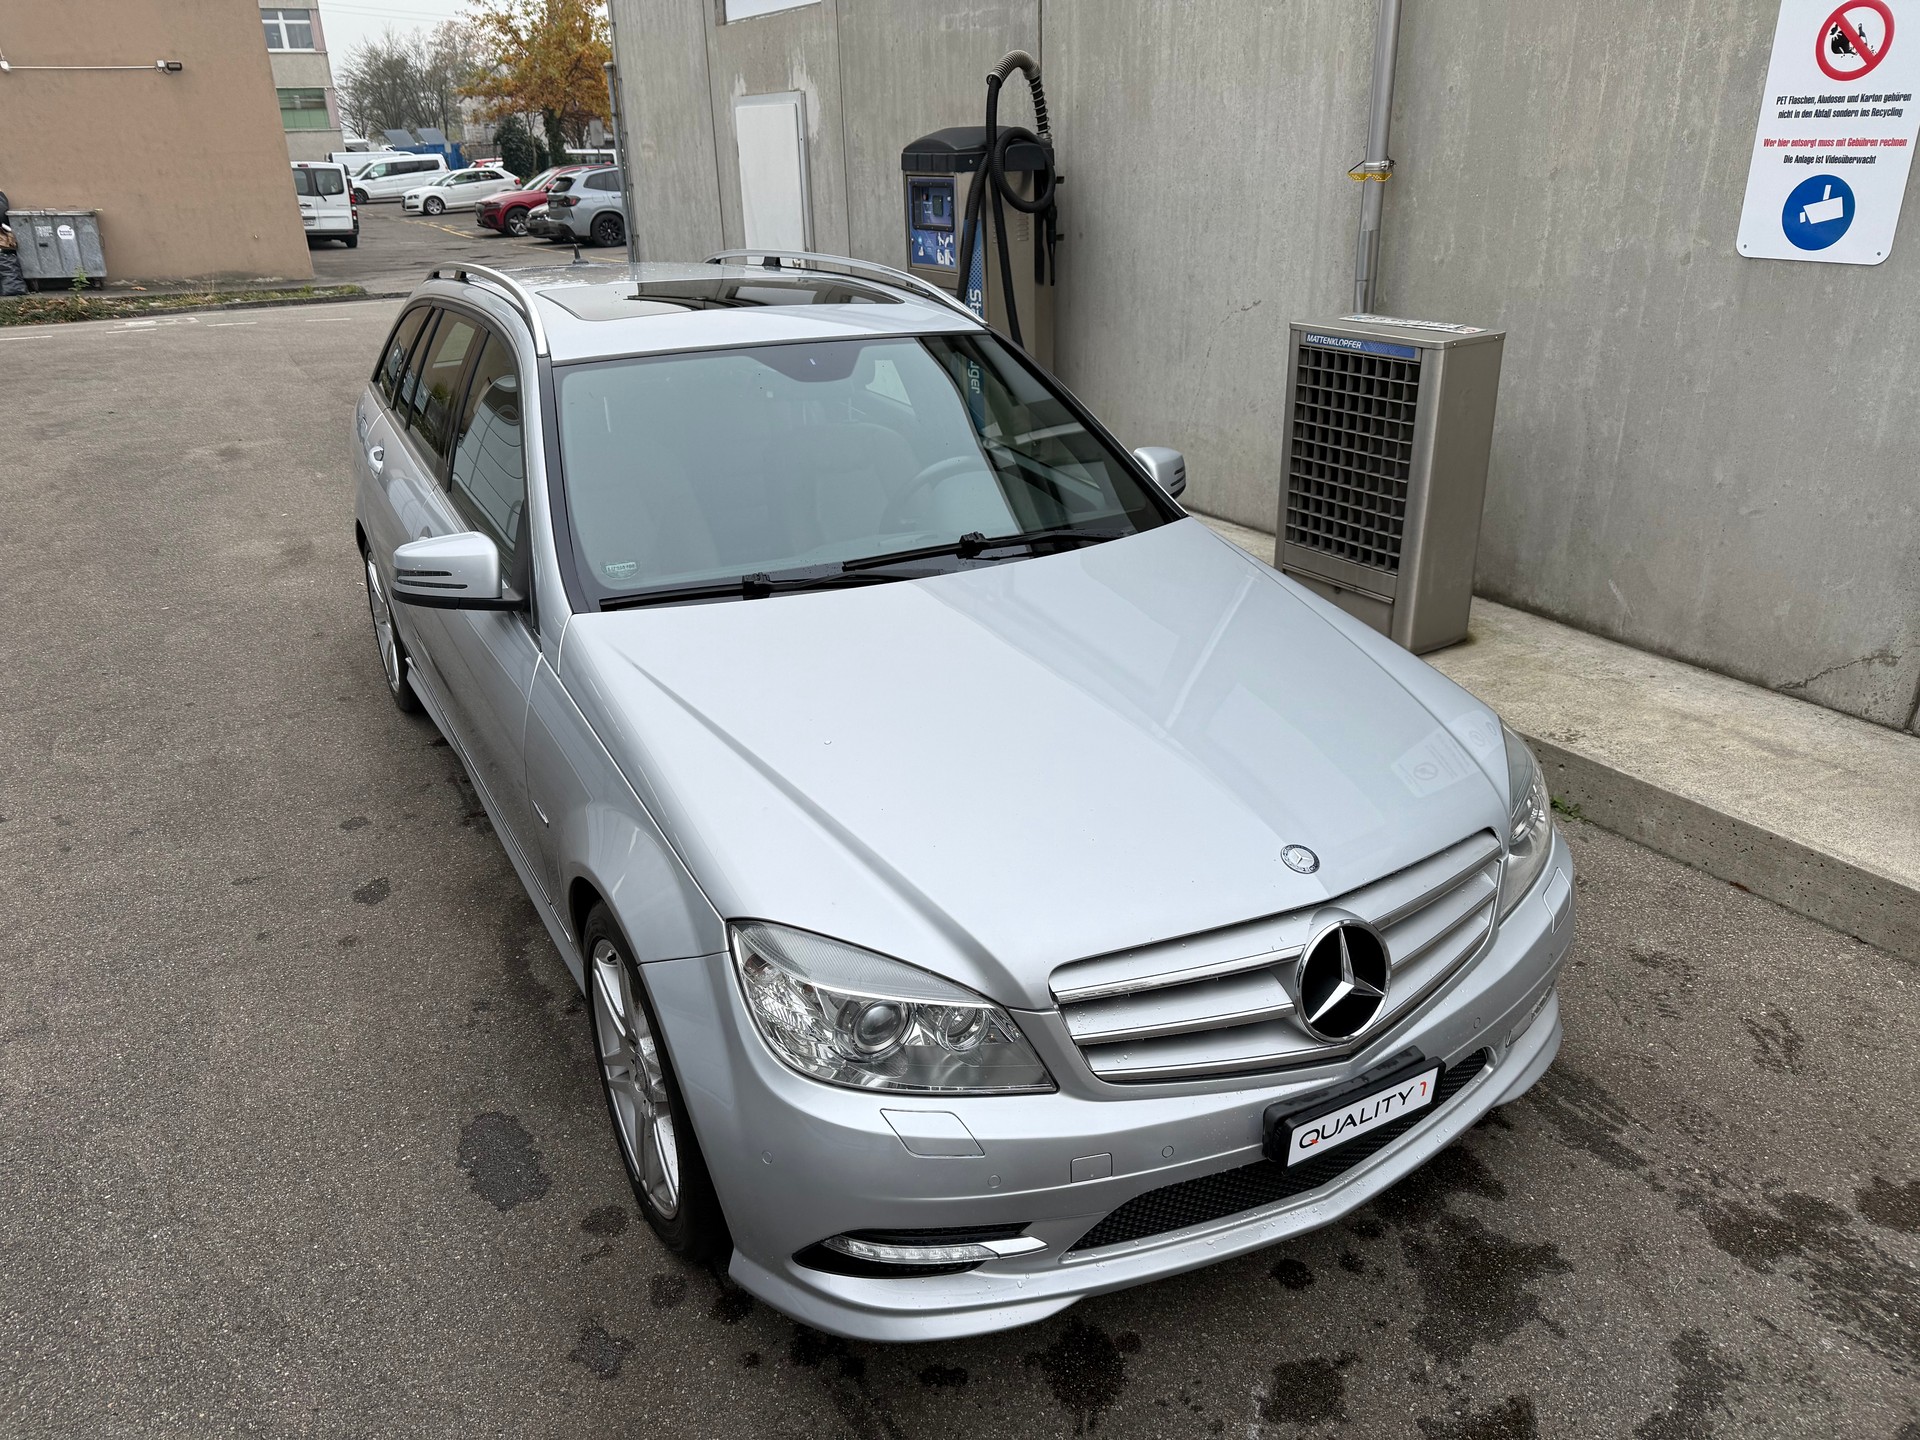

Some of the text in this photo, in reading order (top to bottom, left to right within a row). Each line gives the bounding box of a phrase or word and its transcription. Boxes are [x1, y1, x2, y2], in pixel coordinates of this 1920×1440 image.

[1776, 91, 1912, 105] PET Flaschen, Aludosen und Karton gehören
[1778, 107, 1903, 119] nicht in den Abfall sondern ins Recycling
[1763, 137, 1908, 148] Wer hier entsorgt muss mit Gebühren rechnen
[1783, 154, 1877, 165] Die Anlage ist Videoüberwacht
[1306, 334, 1362, 349] MATTENKLOPFER
[1299, 1081, 1427, 1149] QUALITY 1
